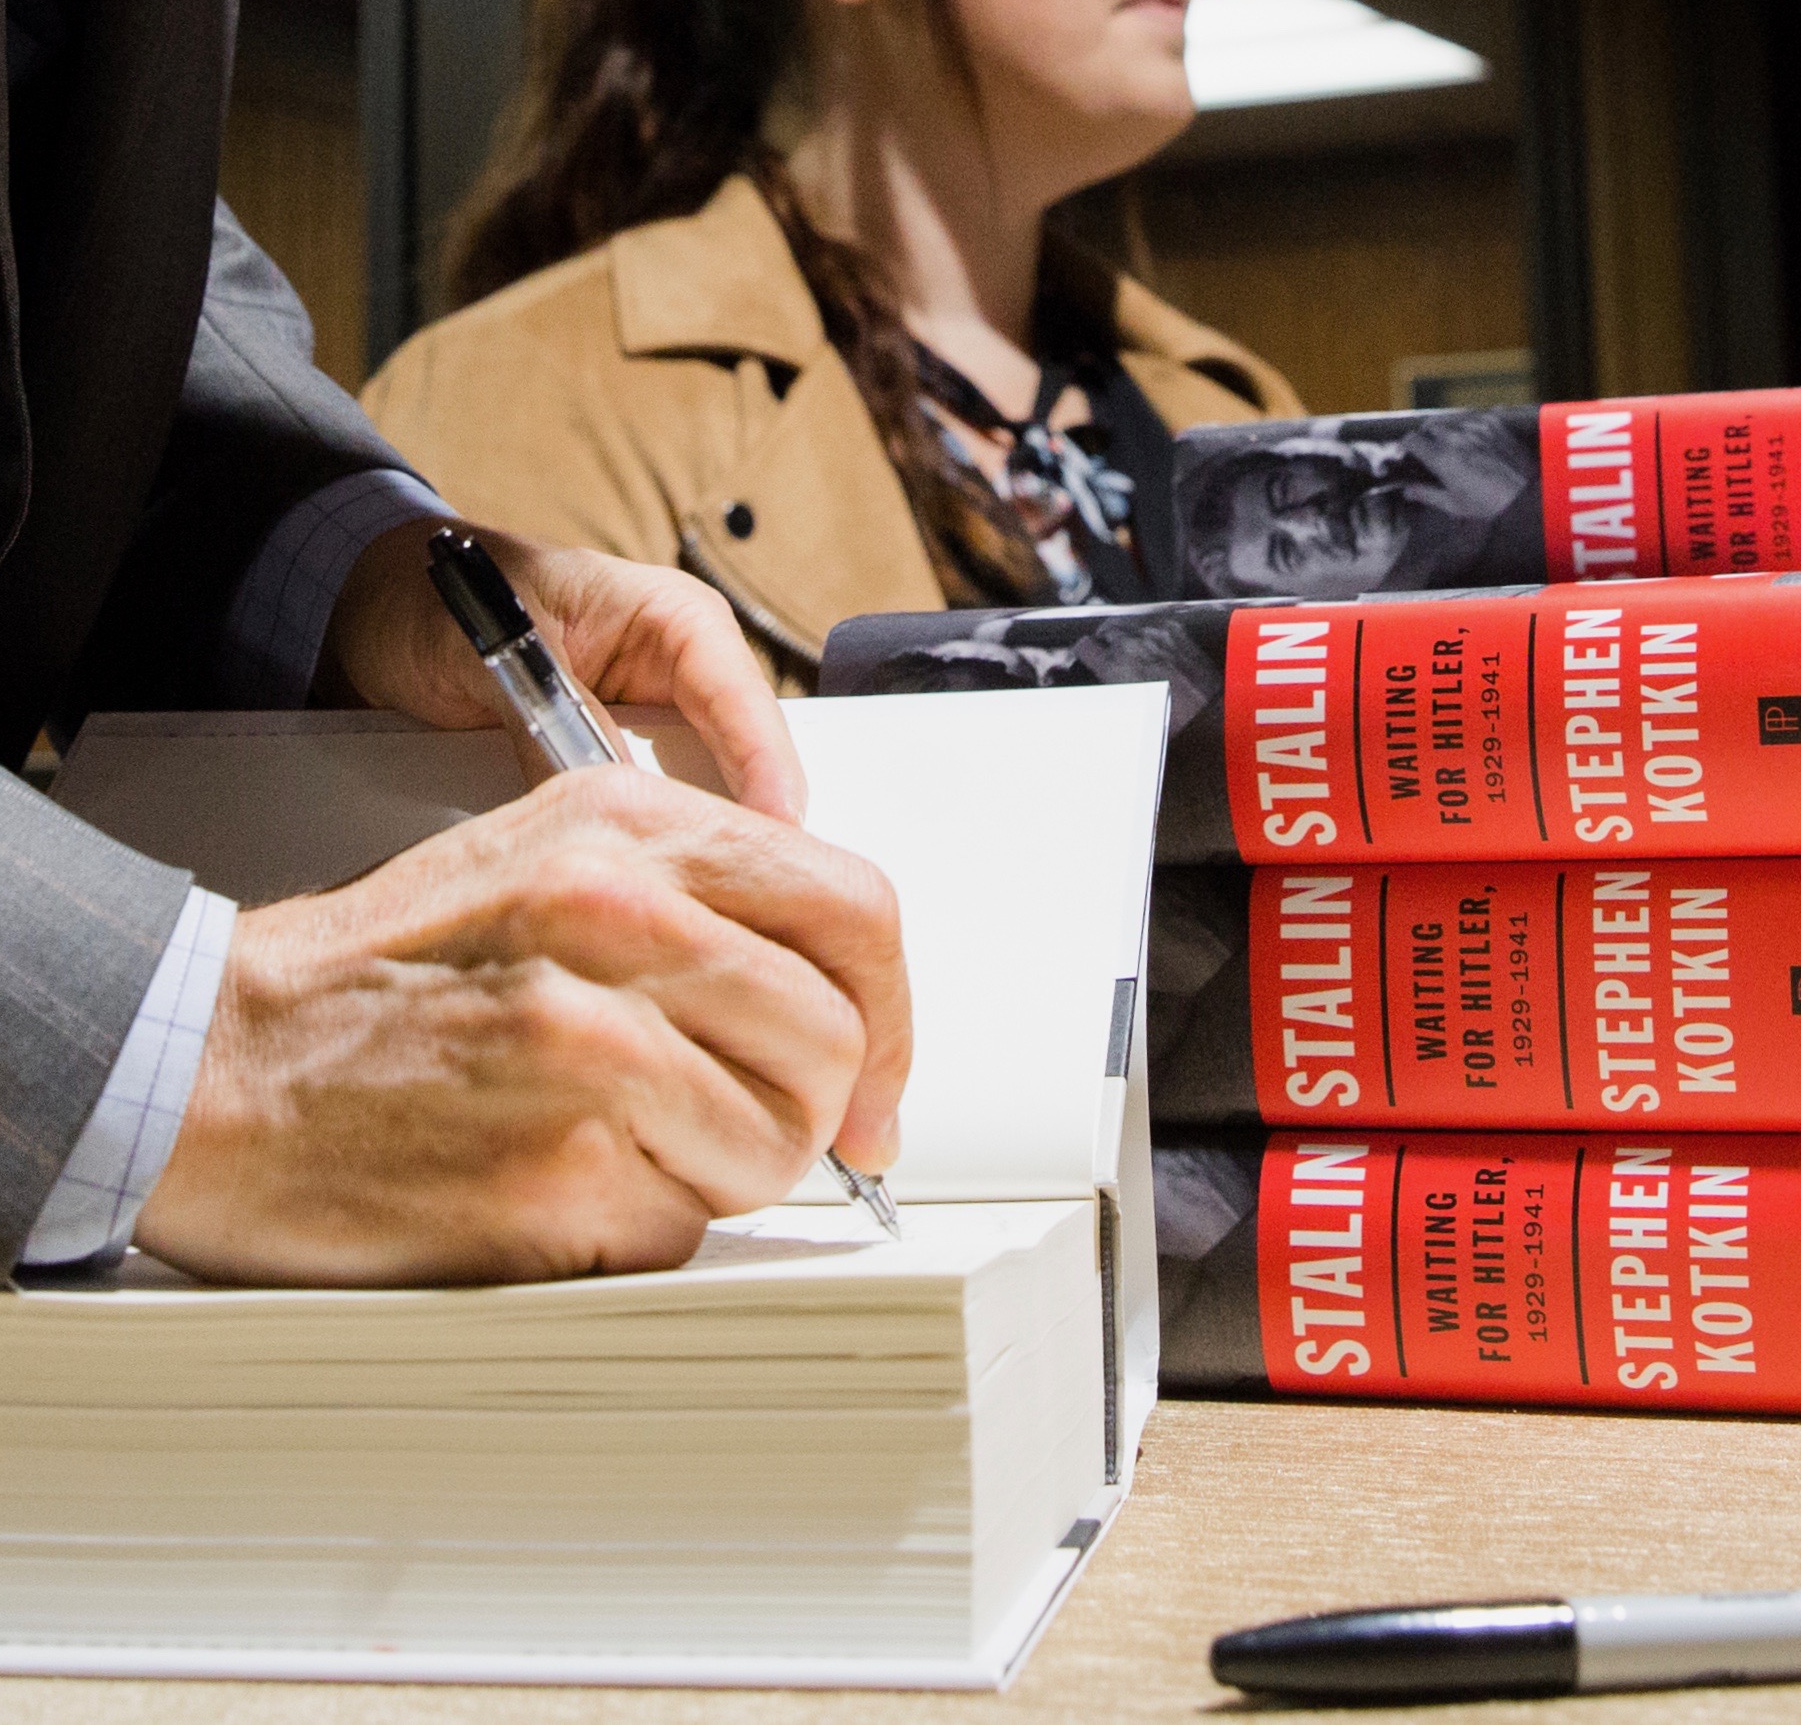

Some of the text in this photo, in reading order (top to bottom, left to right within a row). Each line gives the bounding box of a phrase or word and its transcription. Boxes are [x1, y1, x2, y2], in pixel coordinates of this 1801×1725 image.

[1566, 411, 1638, 578] TALIN
[1684, 446, 1716, 561] WAITING
[1724, 415, 1758, 574] OR HITLER,
[1768, 433, 1791, 560] 1929-1941
[1255, 619, 1337, 846] STALIN
[1385, 666, 1420, 800] WAITING
[1431, 624, 1471, 824] FOR HITLER,
[1480, 654, 1506, 801] 1929-1941
[1564, 606, 1634, 842] STEPHEN
[1640, 623, 1708, 823] KOTKIN
[1280, 875, 1361, 1107] STALIN
[1411, 923, 1447, 1061] WAITING
[1458, 883, 1497, 1088] FOR HITLER,
[1509, 911, 1533, 1069] 1929-1941
[1593, 871, 1661, 1112] STEPHEN
[1671, 889, 1737, 1093] KOTKIN
[1290, 1143, 1371, 1375] STALIN
[1424, 1193, 1459, 1332] WAITING
[1471, 1156, 1512, 1362] FOR HITLER,
[1523, 1186, 1548, 1341] 1929-1941
[1609, 1147, 1678, 1389] STEPHEN
[1688, 1167, 1756, 1373] KOTKIN
